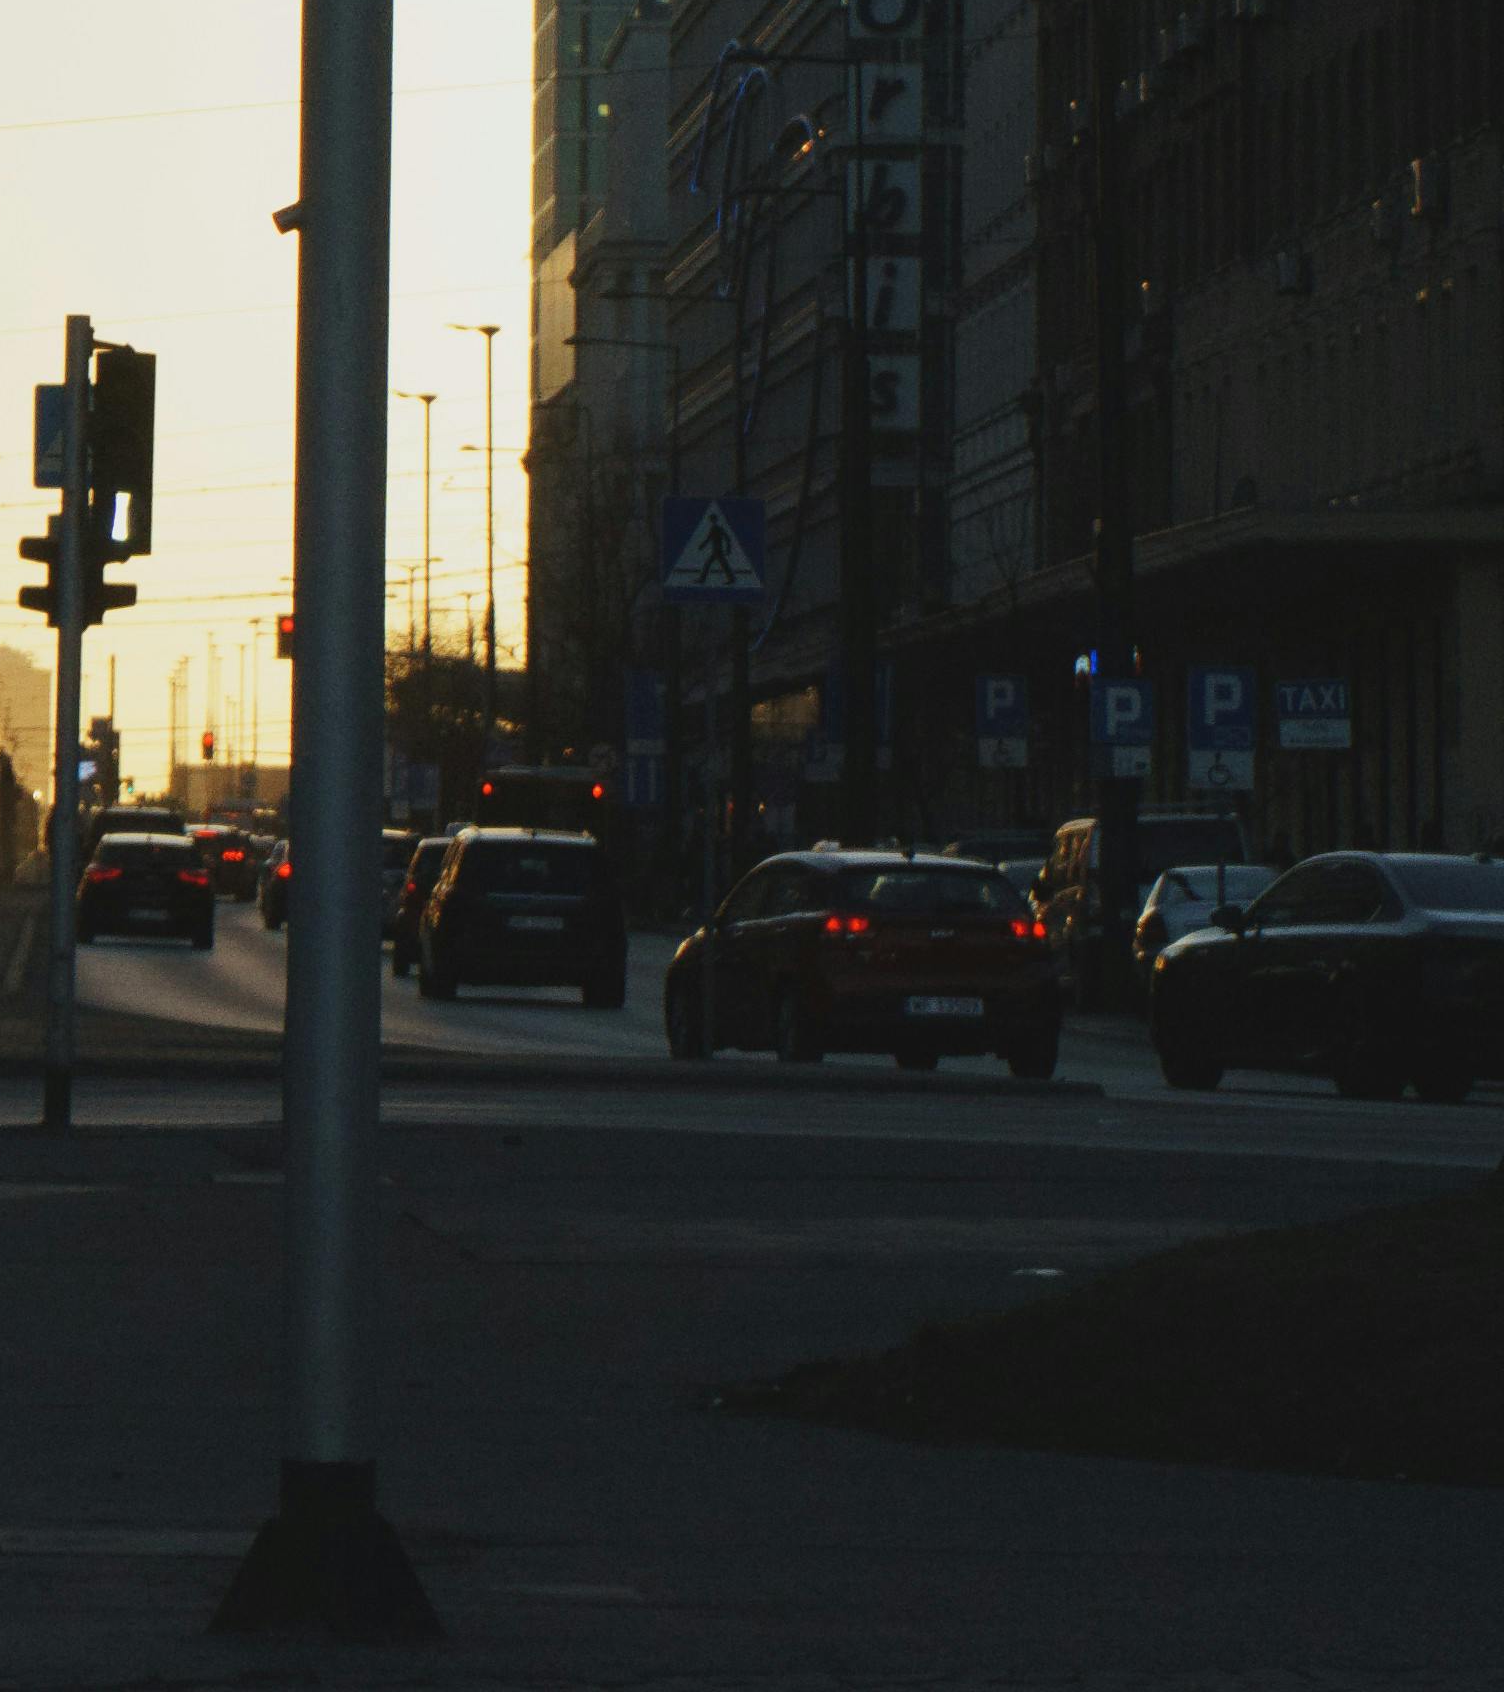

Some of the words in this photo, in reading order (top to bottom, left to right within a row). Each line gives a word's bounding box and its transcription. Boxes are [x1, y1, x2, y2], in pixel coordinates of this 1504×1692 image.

[986, 679, 1015, 719] P
[1106, 686, 1143, 736] P
[1203, 673, 1243, 726] P
[1279, 684, 1346, 713] TAXI
